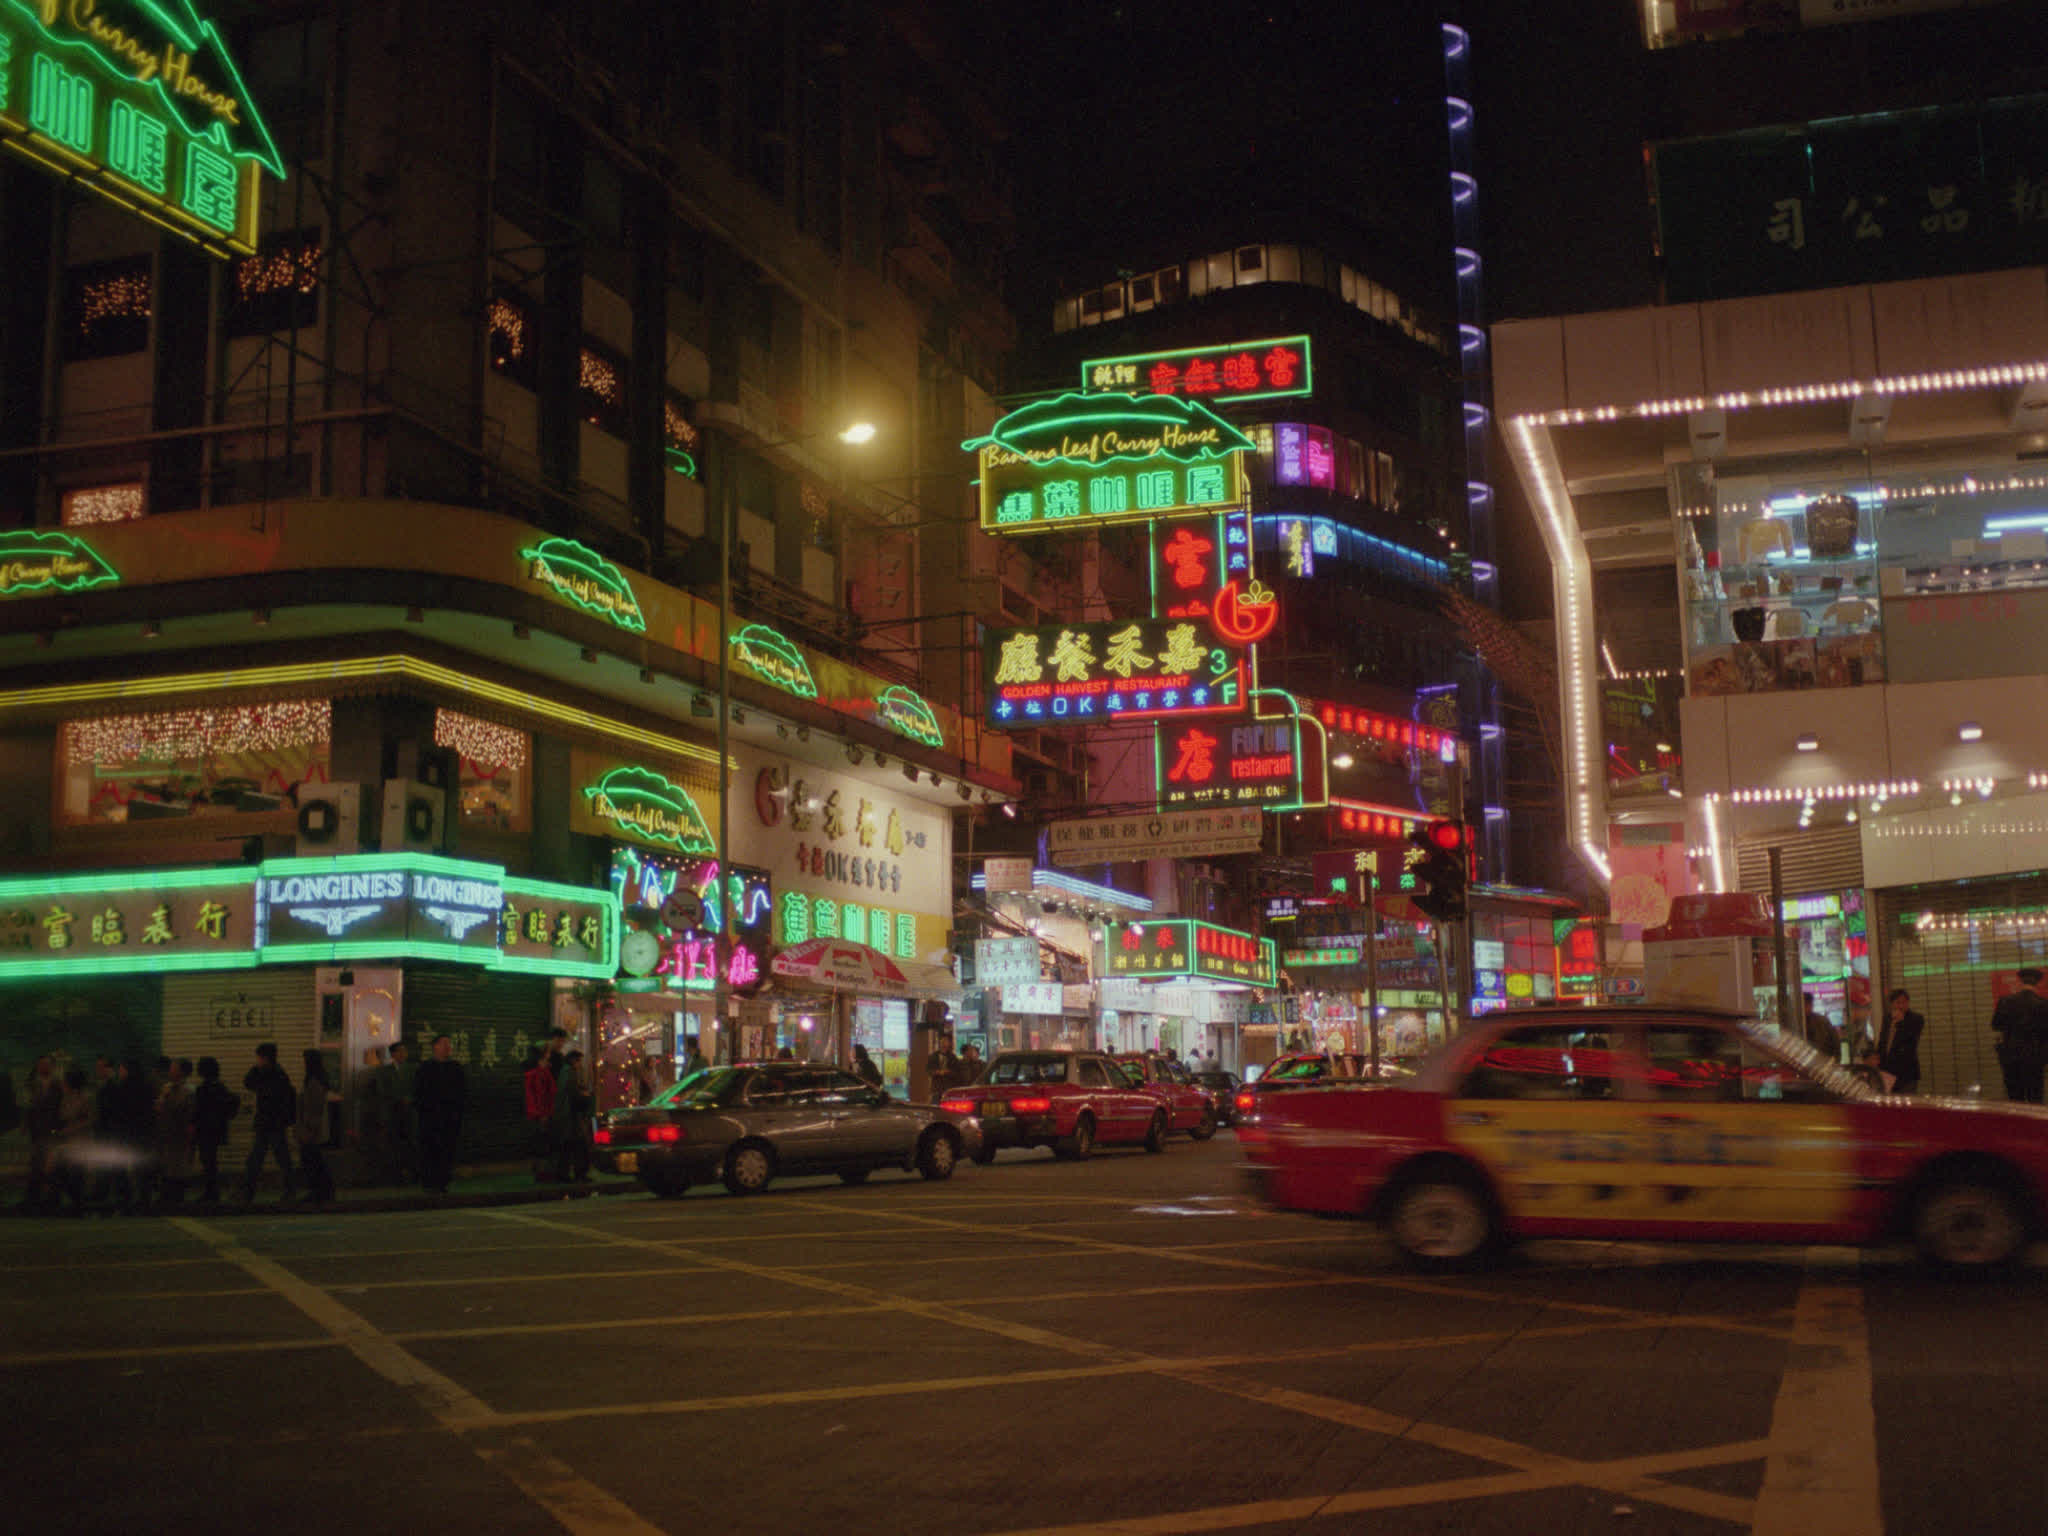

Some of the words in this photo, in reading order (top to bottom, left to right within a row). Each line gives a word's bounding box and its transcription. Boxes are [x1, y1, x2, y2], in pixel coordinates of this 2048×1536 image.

[162, 44, 240, 125] House
[985, 444, 1057, 468] Banana
[1062, 434, 1100, 461] Leaf
[1103, 431, 1161, 455] Curry
[1163, 424, 1219, 447] House
[1002, 685, 1050, 699] GOLDEN
[1055, 681, 1108, 697] HARVEST
[1113, 675, 1190, 692] RESTAURANT
[1231, 754, 1292, 778] restaurant
[1237, 785, 1288, 799] ABALONE
[270, 873, 405, 903] LONGINES
[412, 875, 503, 909] LONGINES
